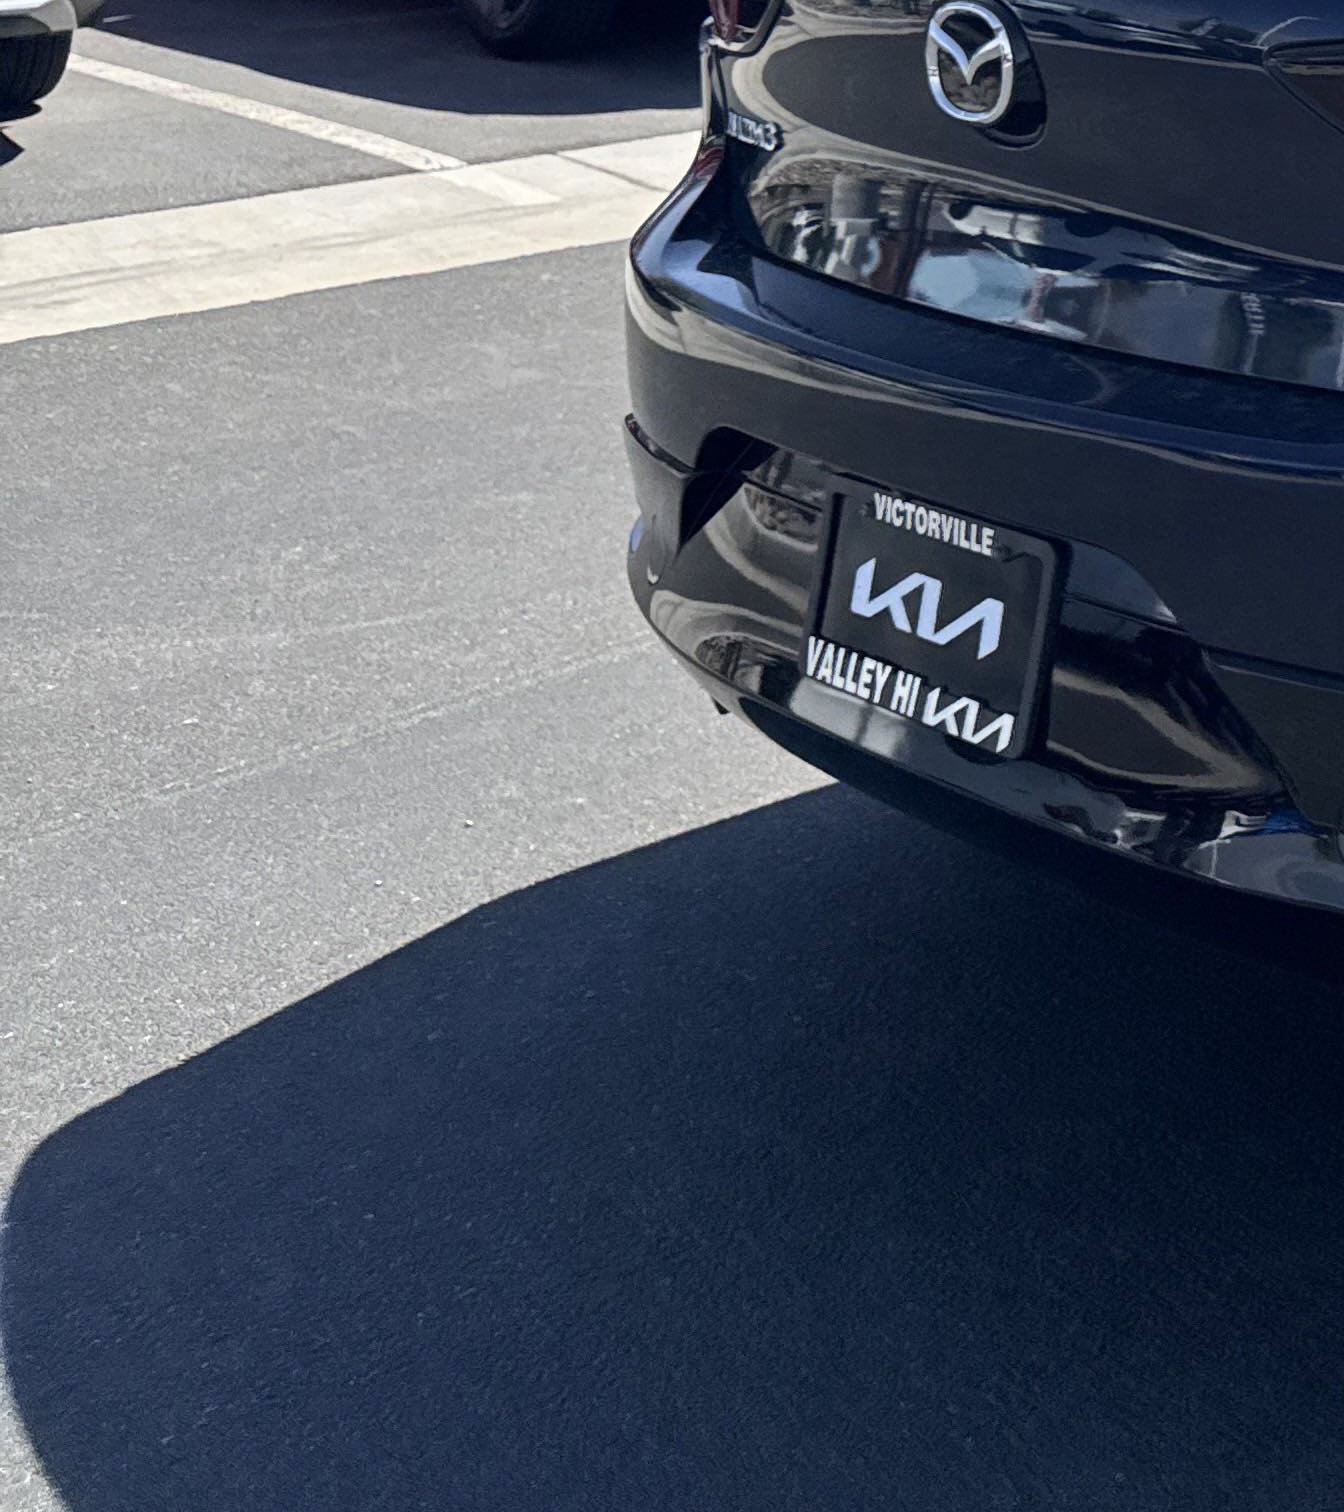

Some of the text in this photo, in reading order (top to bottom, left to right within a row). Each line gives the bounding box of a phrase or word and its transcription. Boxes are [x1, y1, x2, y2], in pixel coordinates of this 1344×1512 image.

[873, 491, 995, 557] VICTORVILLE
[849, 556, 1006, 661] KIA
[805, 635, 1016, 754] VALLEY HI KIA
